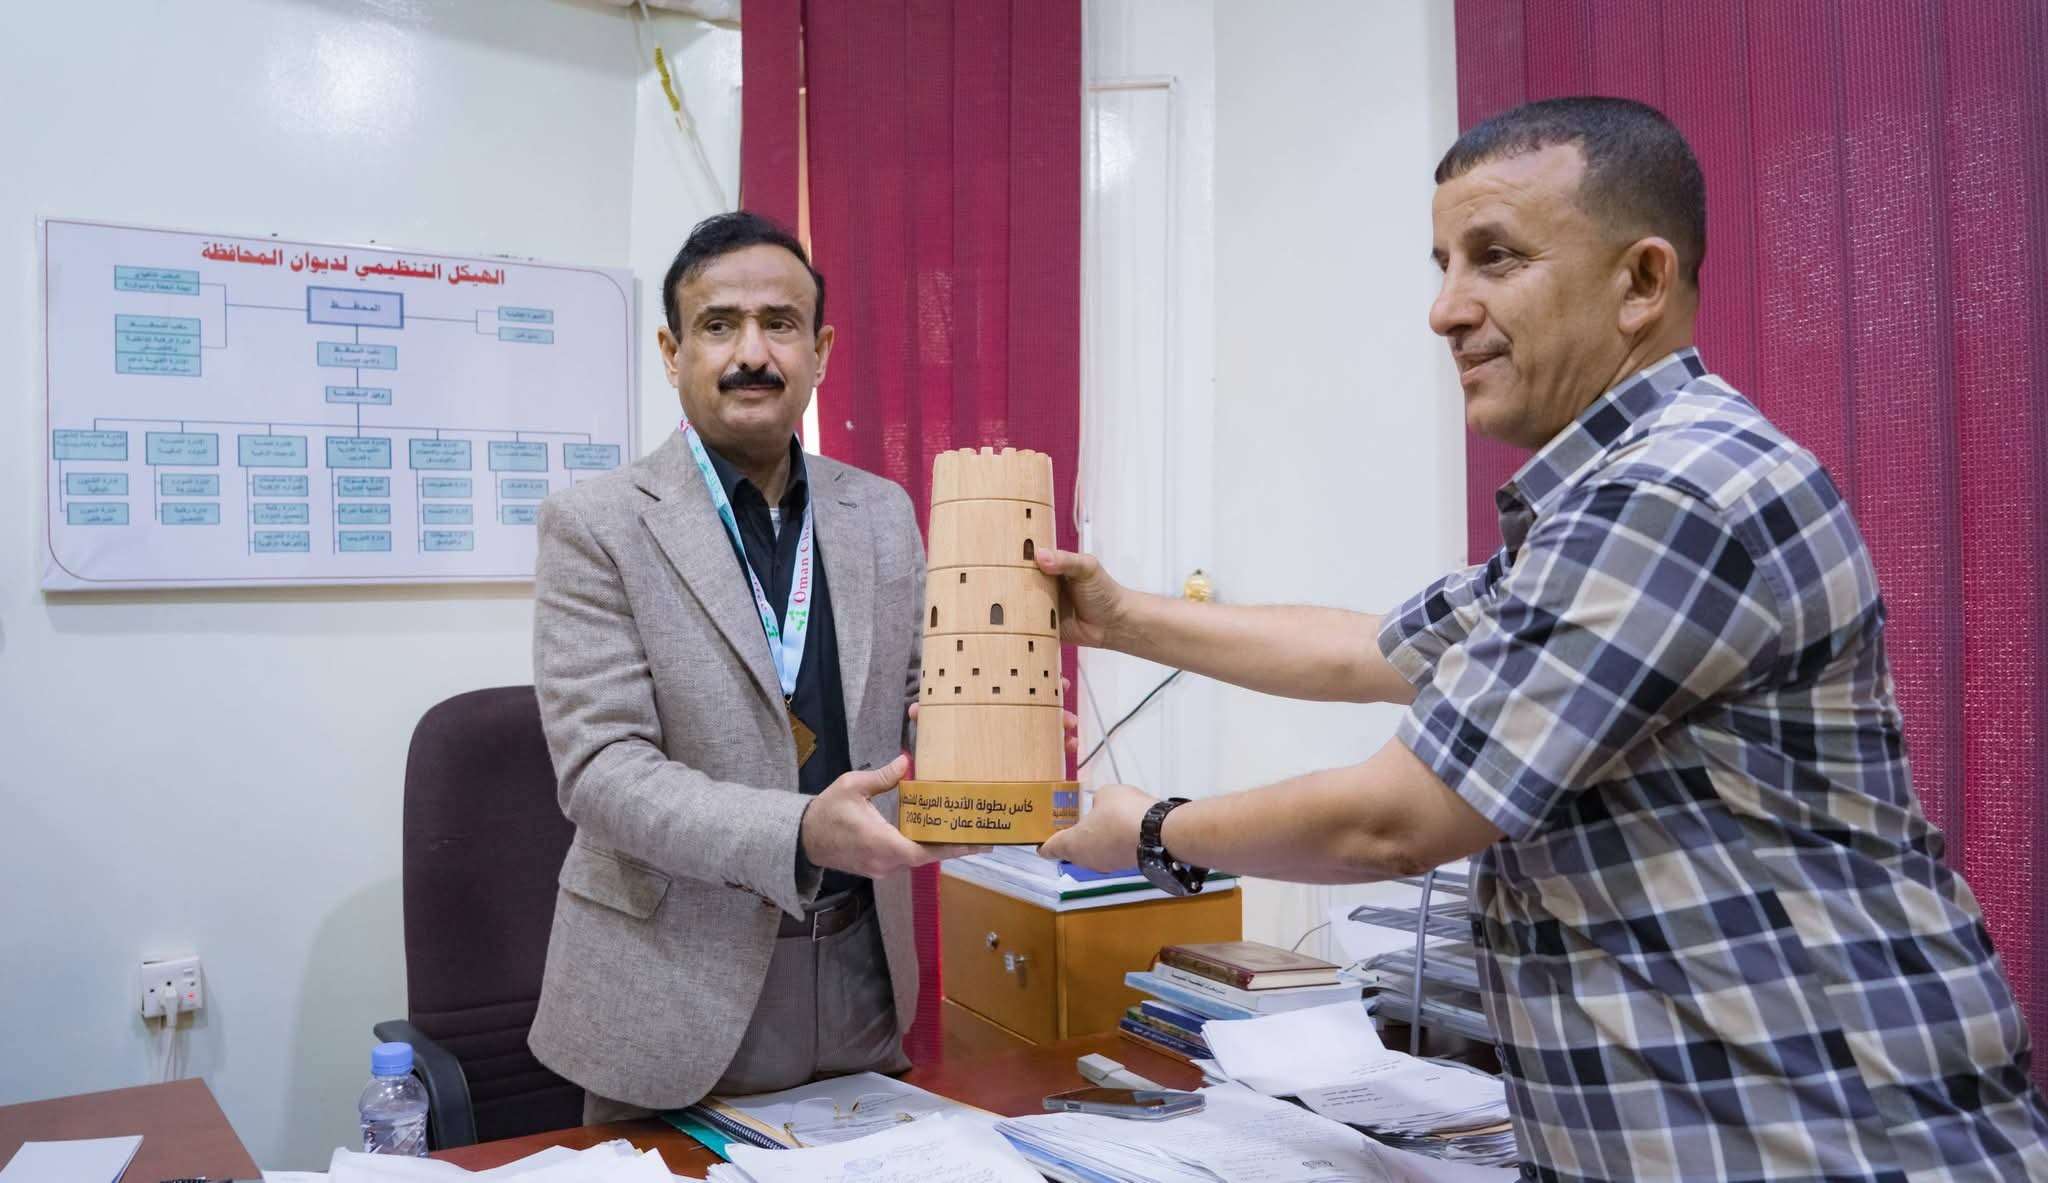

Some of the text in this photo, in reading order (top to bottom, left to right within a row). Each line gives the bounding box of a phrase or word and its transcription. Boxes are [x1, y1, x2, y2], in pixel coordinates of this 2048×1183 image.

[202, 241, 505, 287] الهيكل التنظيمي لديوان المحافظة
[794, 558, 809, 605] Oman
[918, 793, 943, 810] العربية
[943, 795, 975, 812] الأندية
[975, 795, 1008, 814] بطولة
[1008, 797, 1034, 815] كأس
[922, 813, 942, 827] صحار
[950, 815, 974, 831] عمان
[975, 816, 1012, 831] سلطنة
